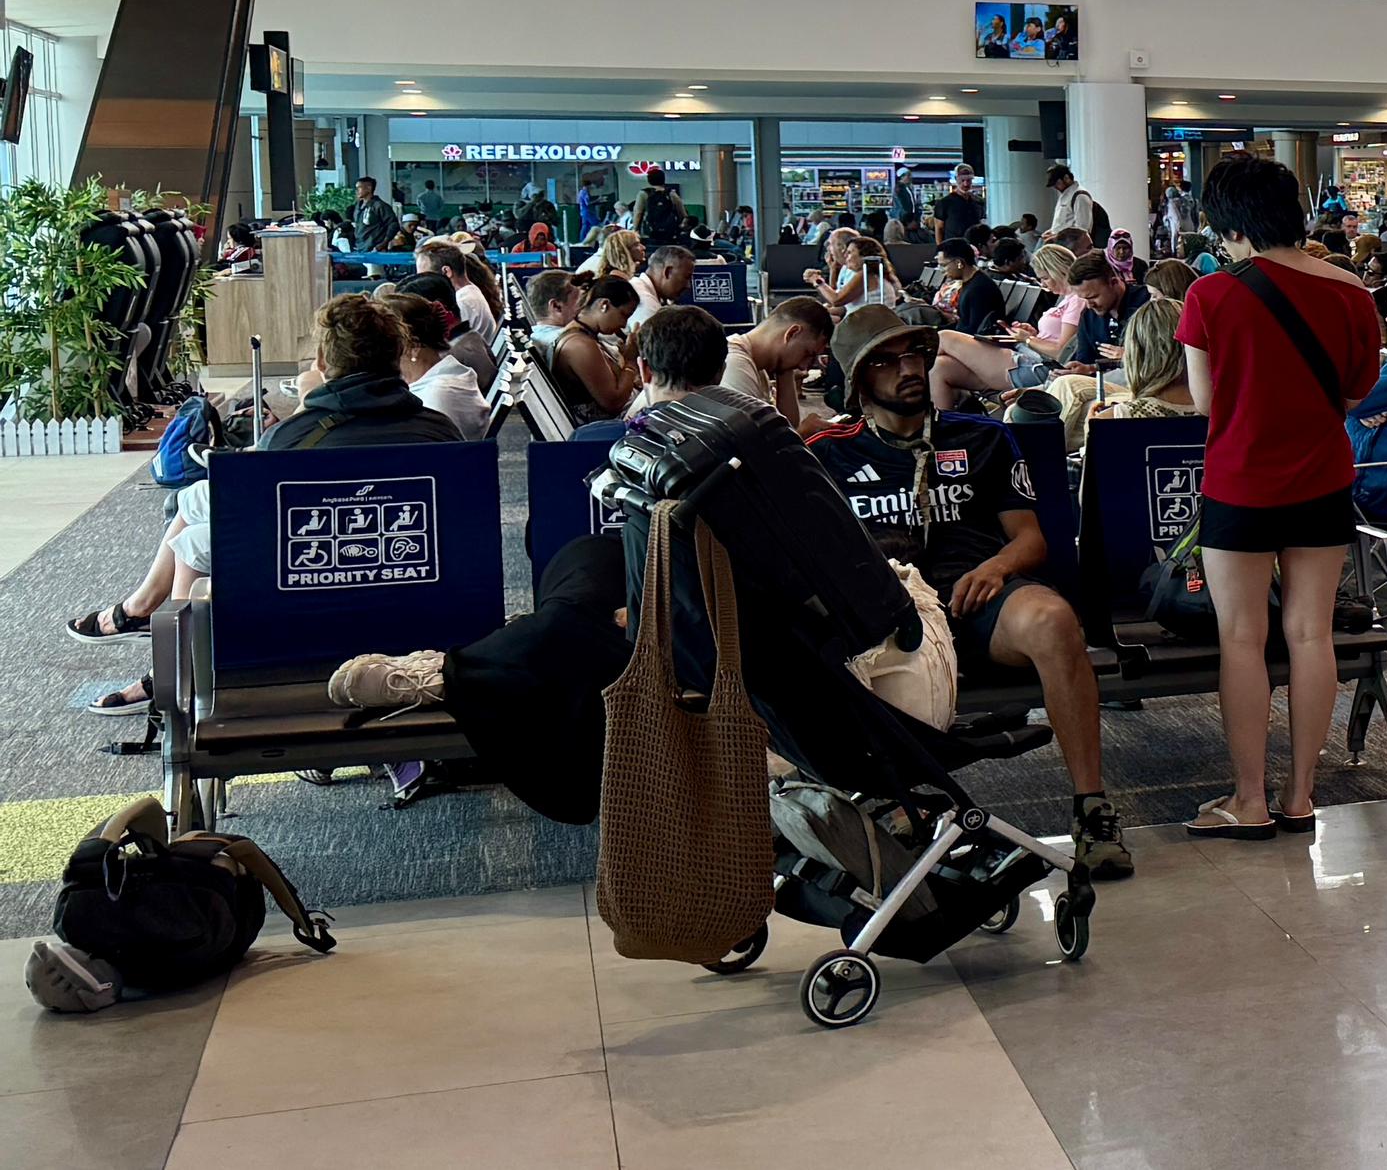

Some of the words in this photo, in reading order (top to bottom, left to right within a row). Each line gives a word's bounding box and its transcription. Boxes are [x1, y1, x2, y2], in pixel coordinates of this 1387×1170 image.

[466, 145, 622, 160] REFLEXOLOGY
[665, 161, 700, 170] IKN
[288, 569, 378, 585] PRIORITY
[381, 566, 430, 580] SEAT
